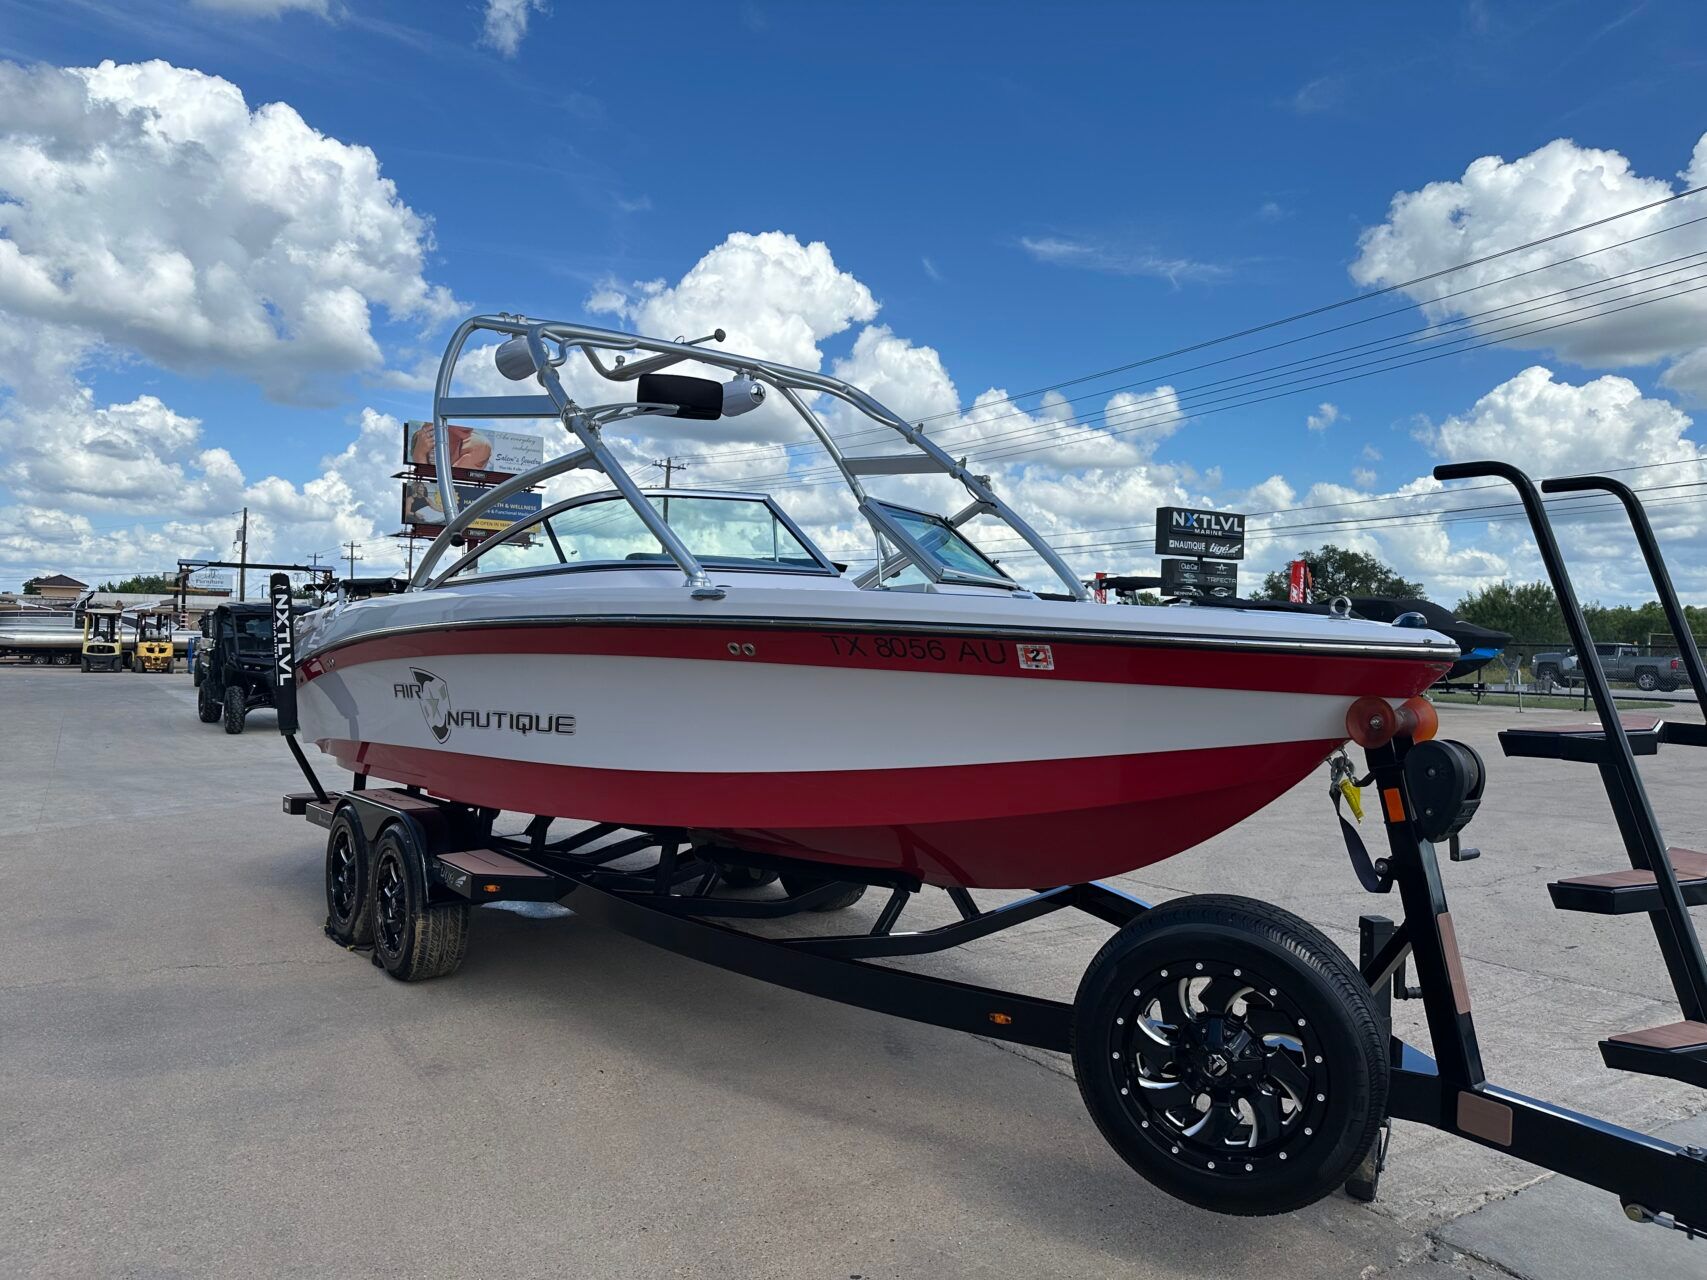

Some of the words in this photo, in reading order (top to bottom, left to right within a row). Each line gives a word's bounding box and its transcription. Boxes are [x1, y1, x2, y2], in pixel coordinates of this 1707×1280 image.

[1172, 511, 1243, 532] NXTLVL
[1194, 528, 1222, 536] MARINE
[1174, 540, 1206, 550] NAUTIQUE
[1206, 576, 1237, 584] TRIFECTA
[275, 594, 292, 686] NXTLVL
[822, 634, 867, 657] TX
[876, 637, 946, 661] 8056
[958, 641, 1007, 665] AU
[393, 684, 422, 699] AIR
[446, 710, 577, 736] NAUTIQUE
